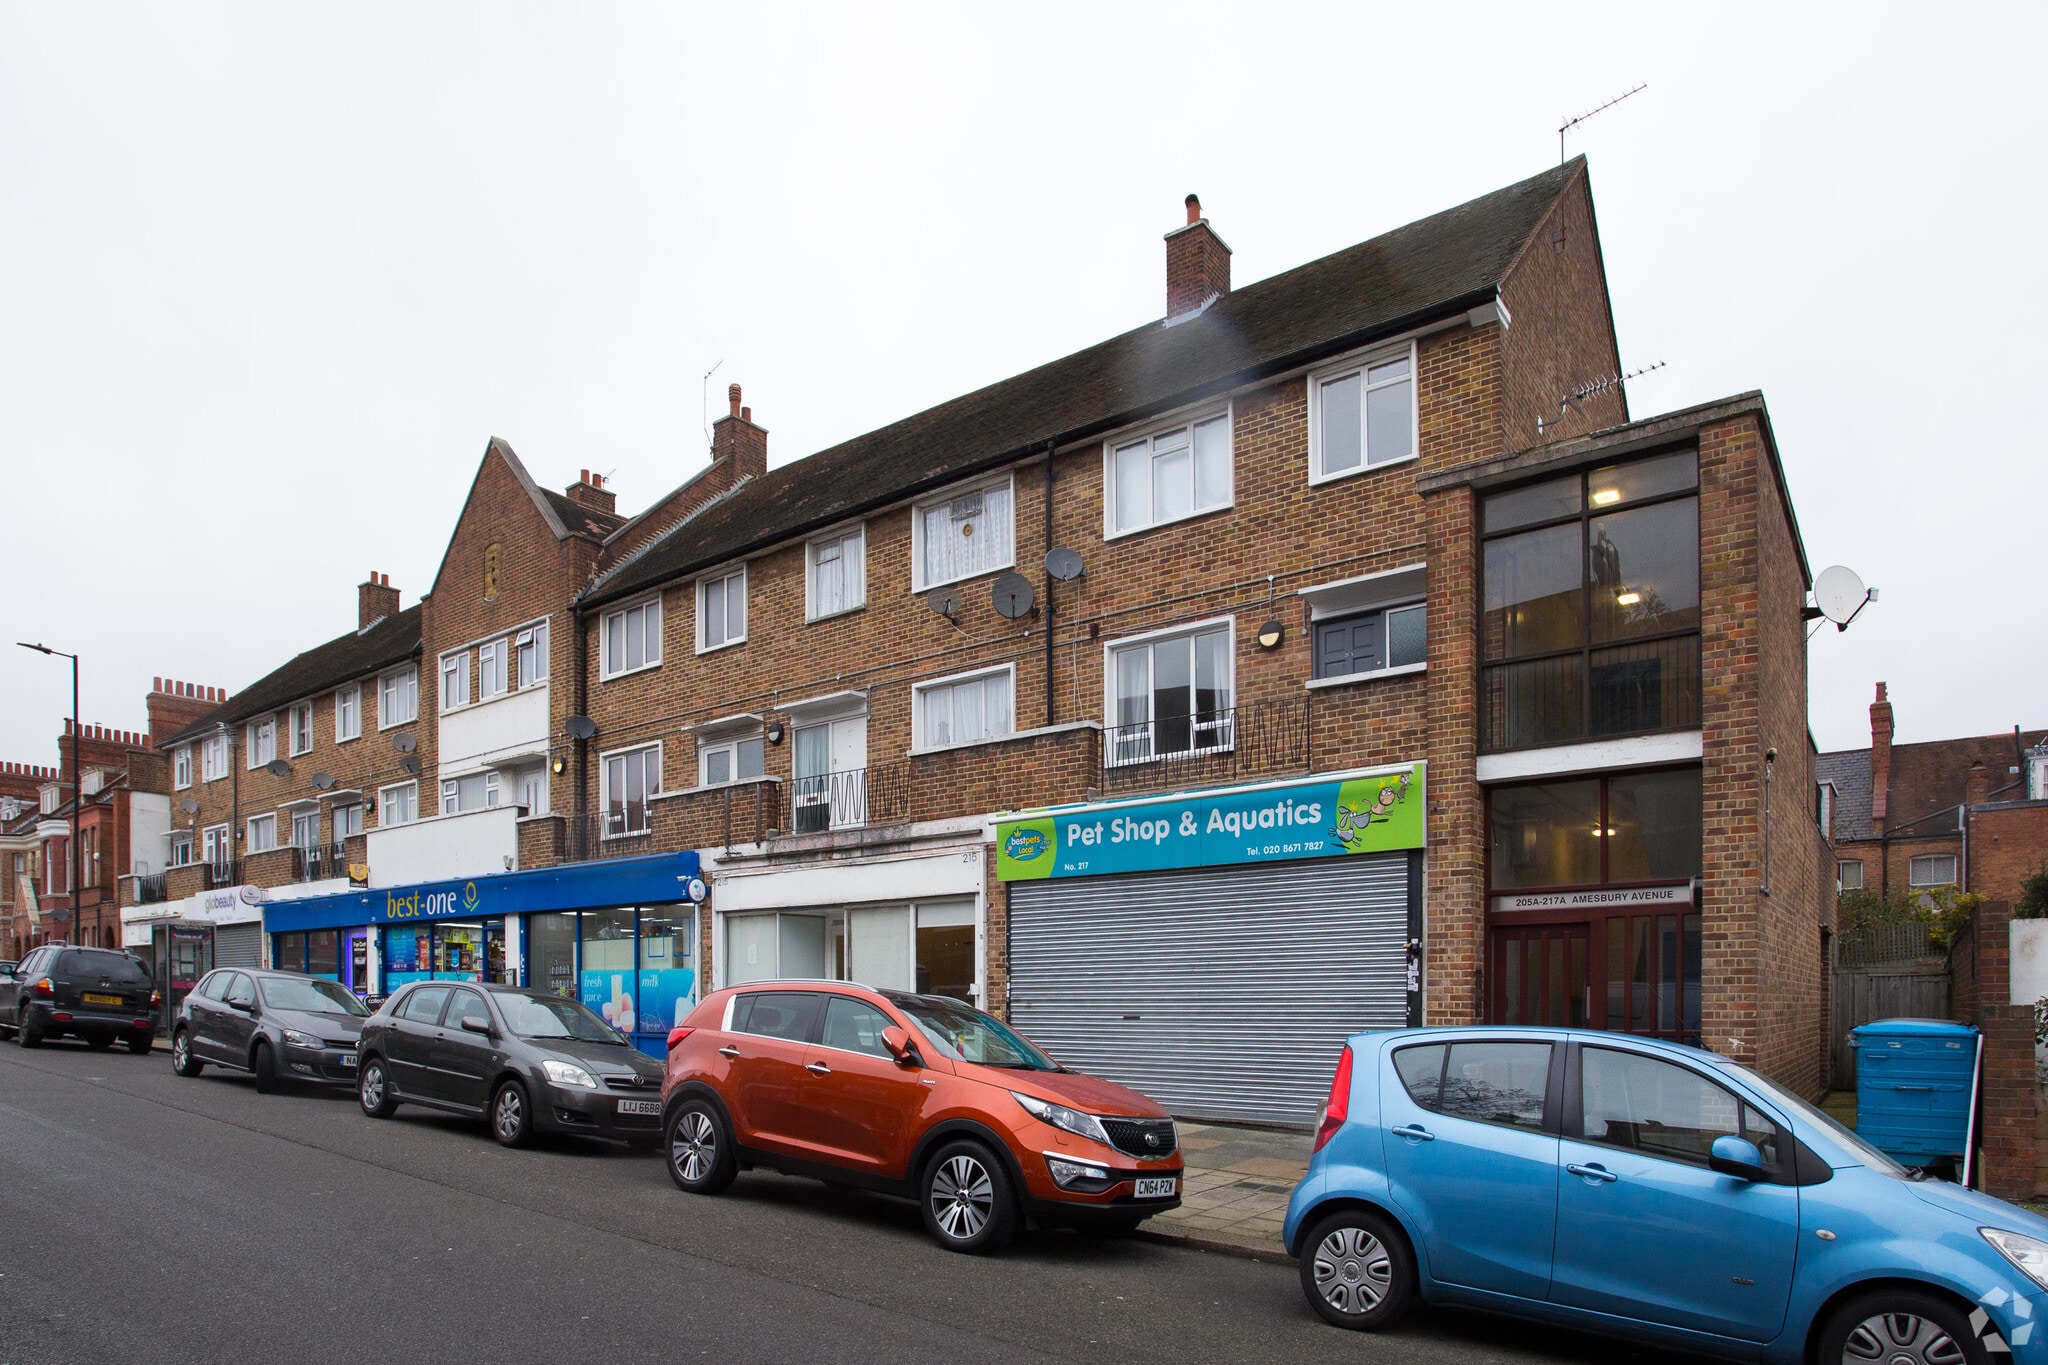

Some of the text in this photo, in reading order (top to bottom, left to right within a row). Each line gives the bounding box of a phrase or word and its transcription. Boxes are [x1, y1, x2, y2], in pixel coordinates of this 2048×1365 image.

[1068, 798, 1322, 847] Pet Shop & Aquatics
[1011, 835, 1041, 846] bestpets
[1018, 846, 1034, 854] Local
[1246, 841, 1324, 856] Tel. 020 8671 7827
[963, 853, 977, 863] 215
[1064, 862, 1089, 871] No. 217
[717, 878, 729, 887] 215
[387, 890, 457, 919] best-one
[1516, 890, 1674, 907] 205A-217A AMESBURY AVENUE
[584, 975, 602, 988] fresh
[641, 974, 660, 988] milk
[584, 990, 602, 1005] juice
[623, 1101, 638, 1112] LIJ
[1138, 1179, 1158, 1195] CN64
